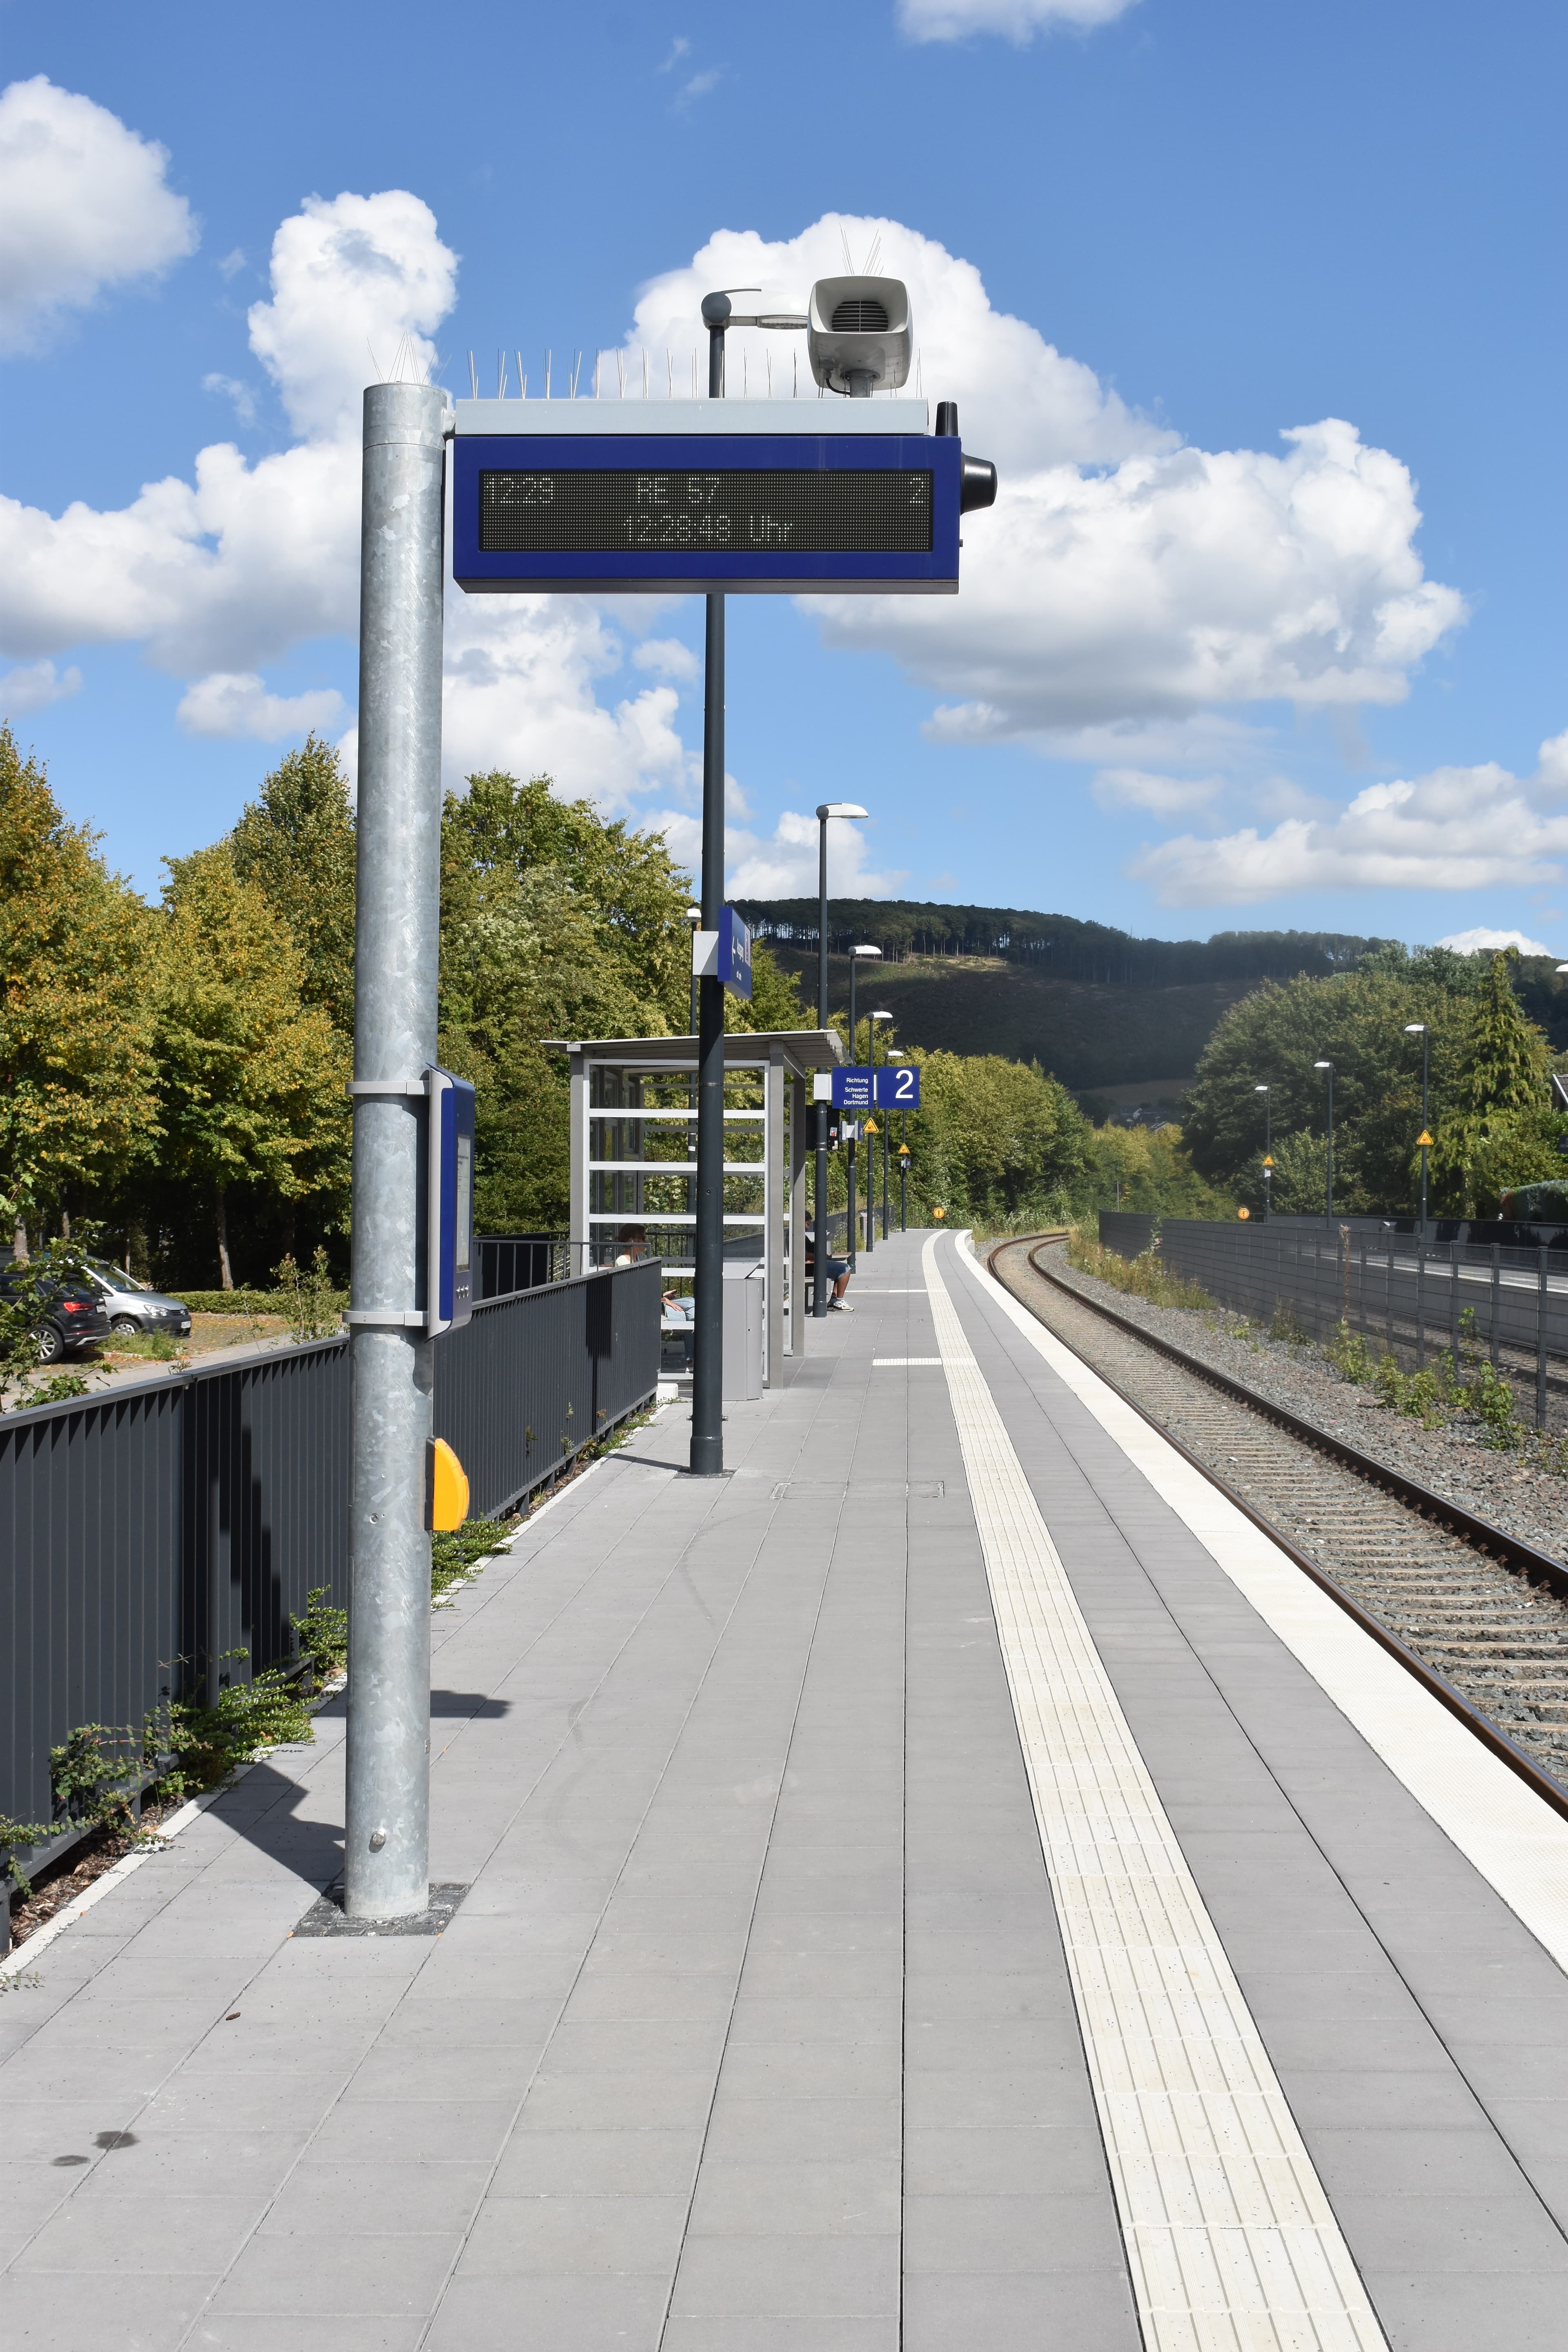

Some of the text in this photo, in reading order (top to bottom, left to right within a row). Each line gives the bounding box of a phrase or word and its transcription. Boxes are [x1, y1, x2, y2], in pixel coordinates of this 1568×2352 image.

[486, 478, 553, 503] 12:29
[638, 478, 719, 503] RE 57
[909, 478, 924, 503] 2
[623, 515, 793, 541] 12:28:48 Uhr
[895, 1069, 913, 1098] 2
